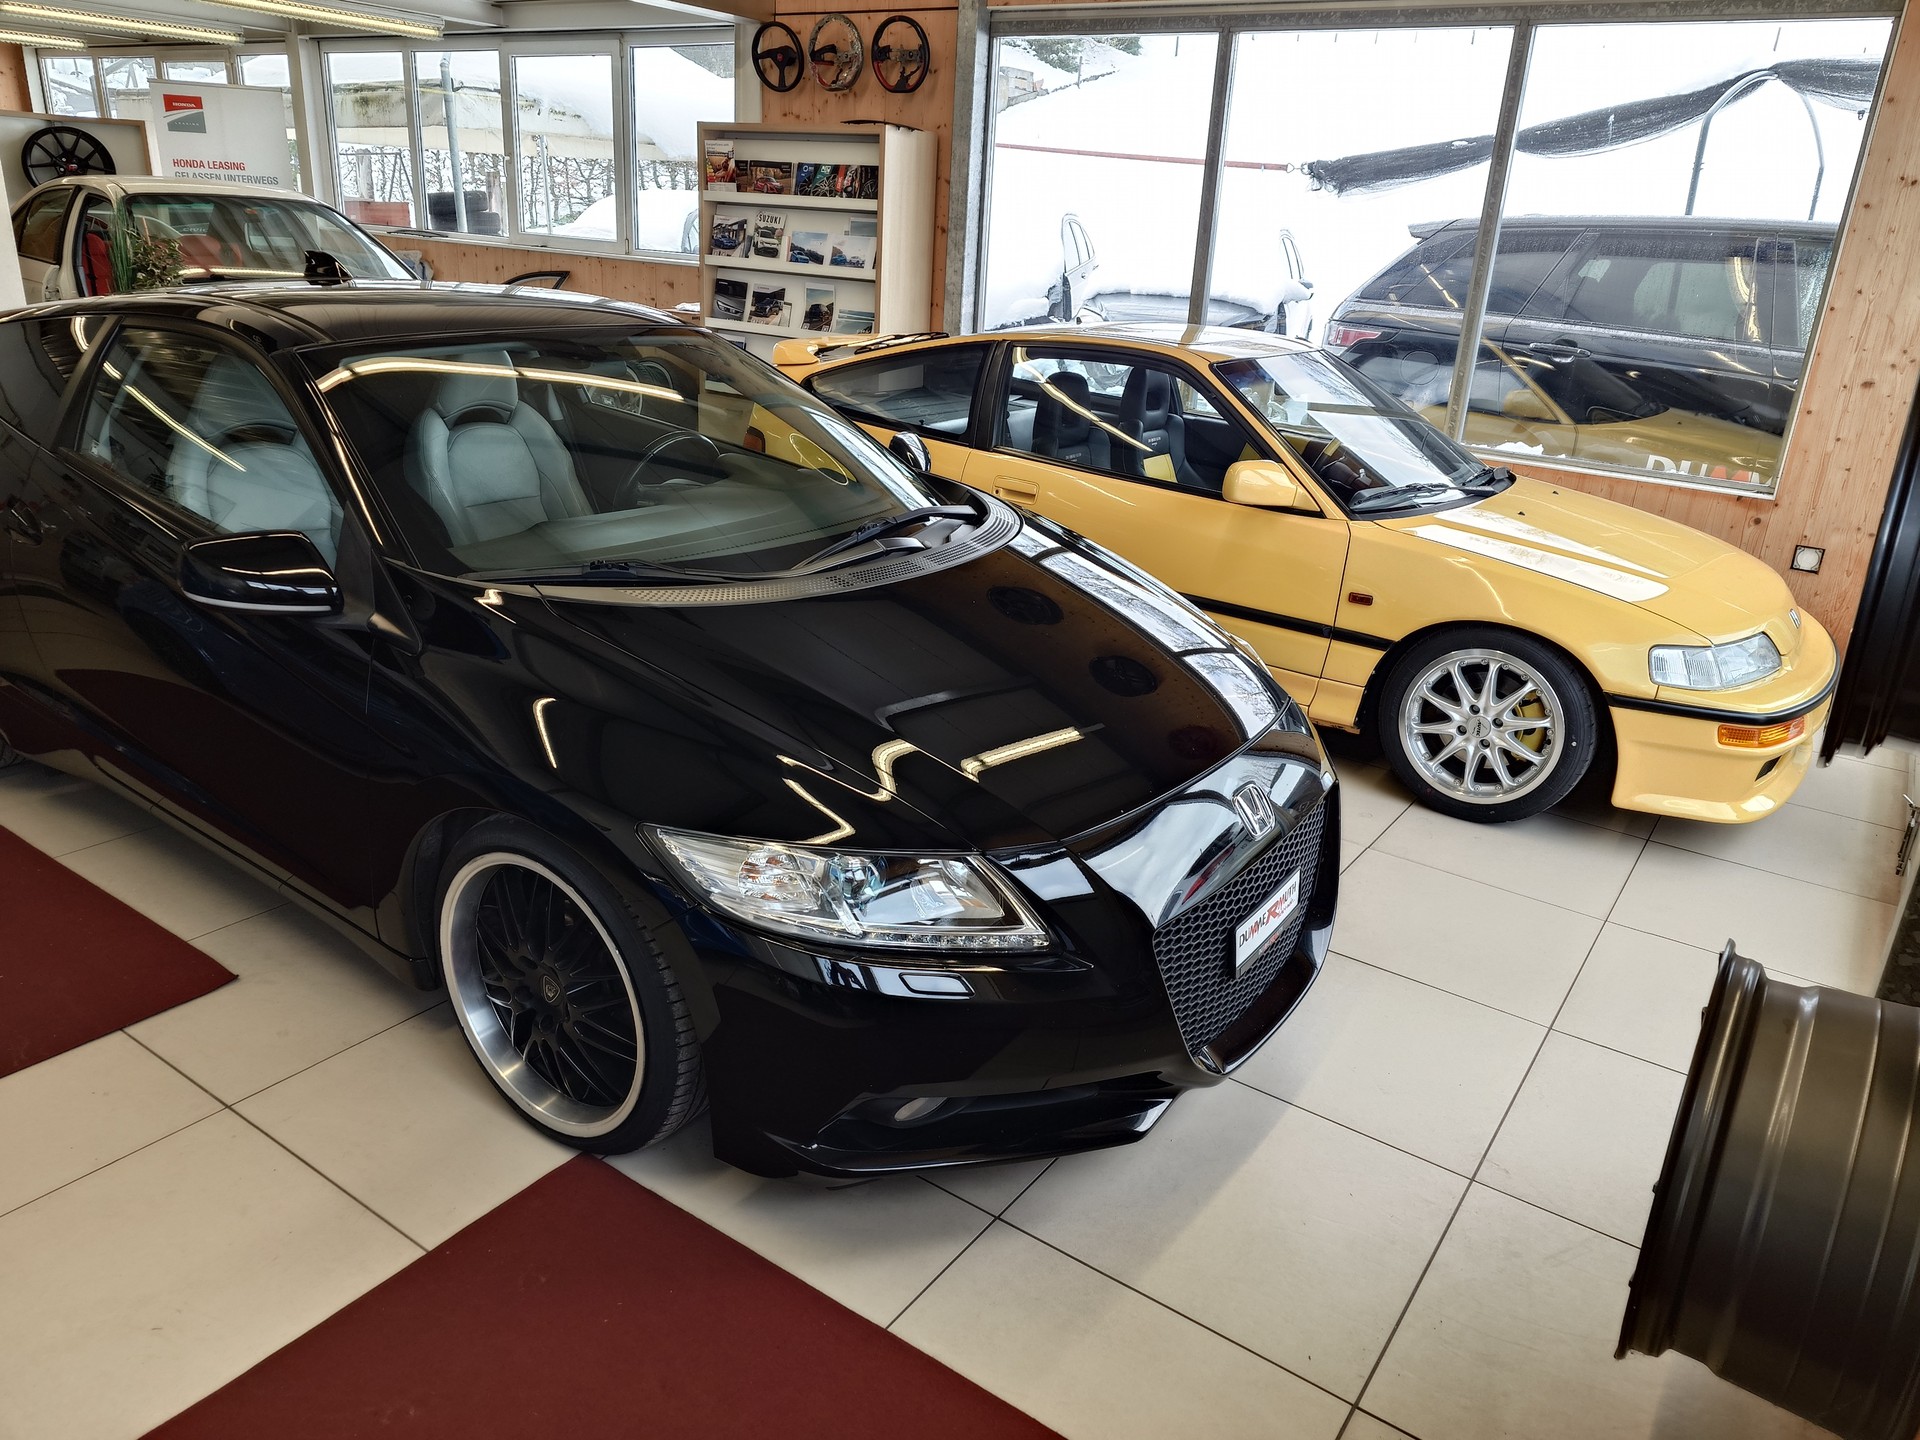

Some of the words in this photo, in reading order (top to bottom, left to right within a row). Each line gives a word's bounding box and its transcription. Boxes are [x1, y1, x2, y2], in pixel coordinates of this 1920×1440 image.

[172, 158, 205, 169] HONDA
[207, 160, 246, 171] LEASING
[174, 171, 222, 181] GELASSEN
[223, 174, 279, 185] UNTERWEGS
[758, 213, 782, 225] SUZUKI
